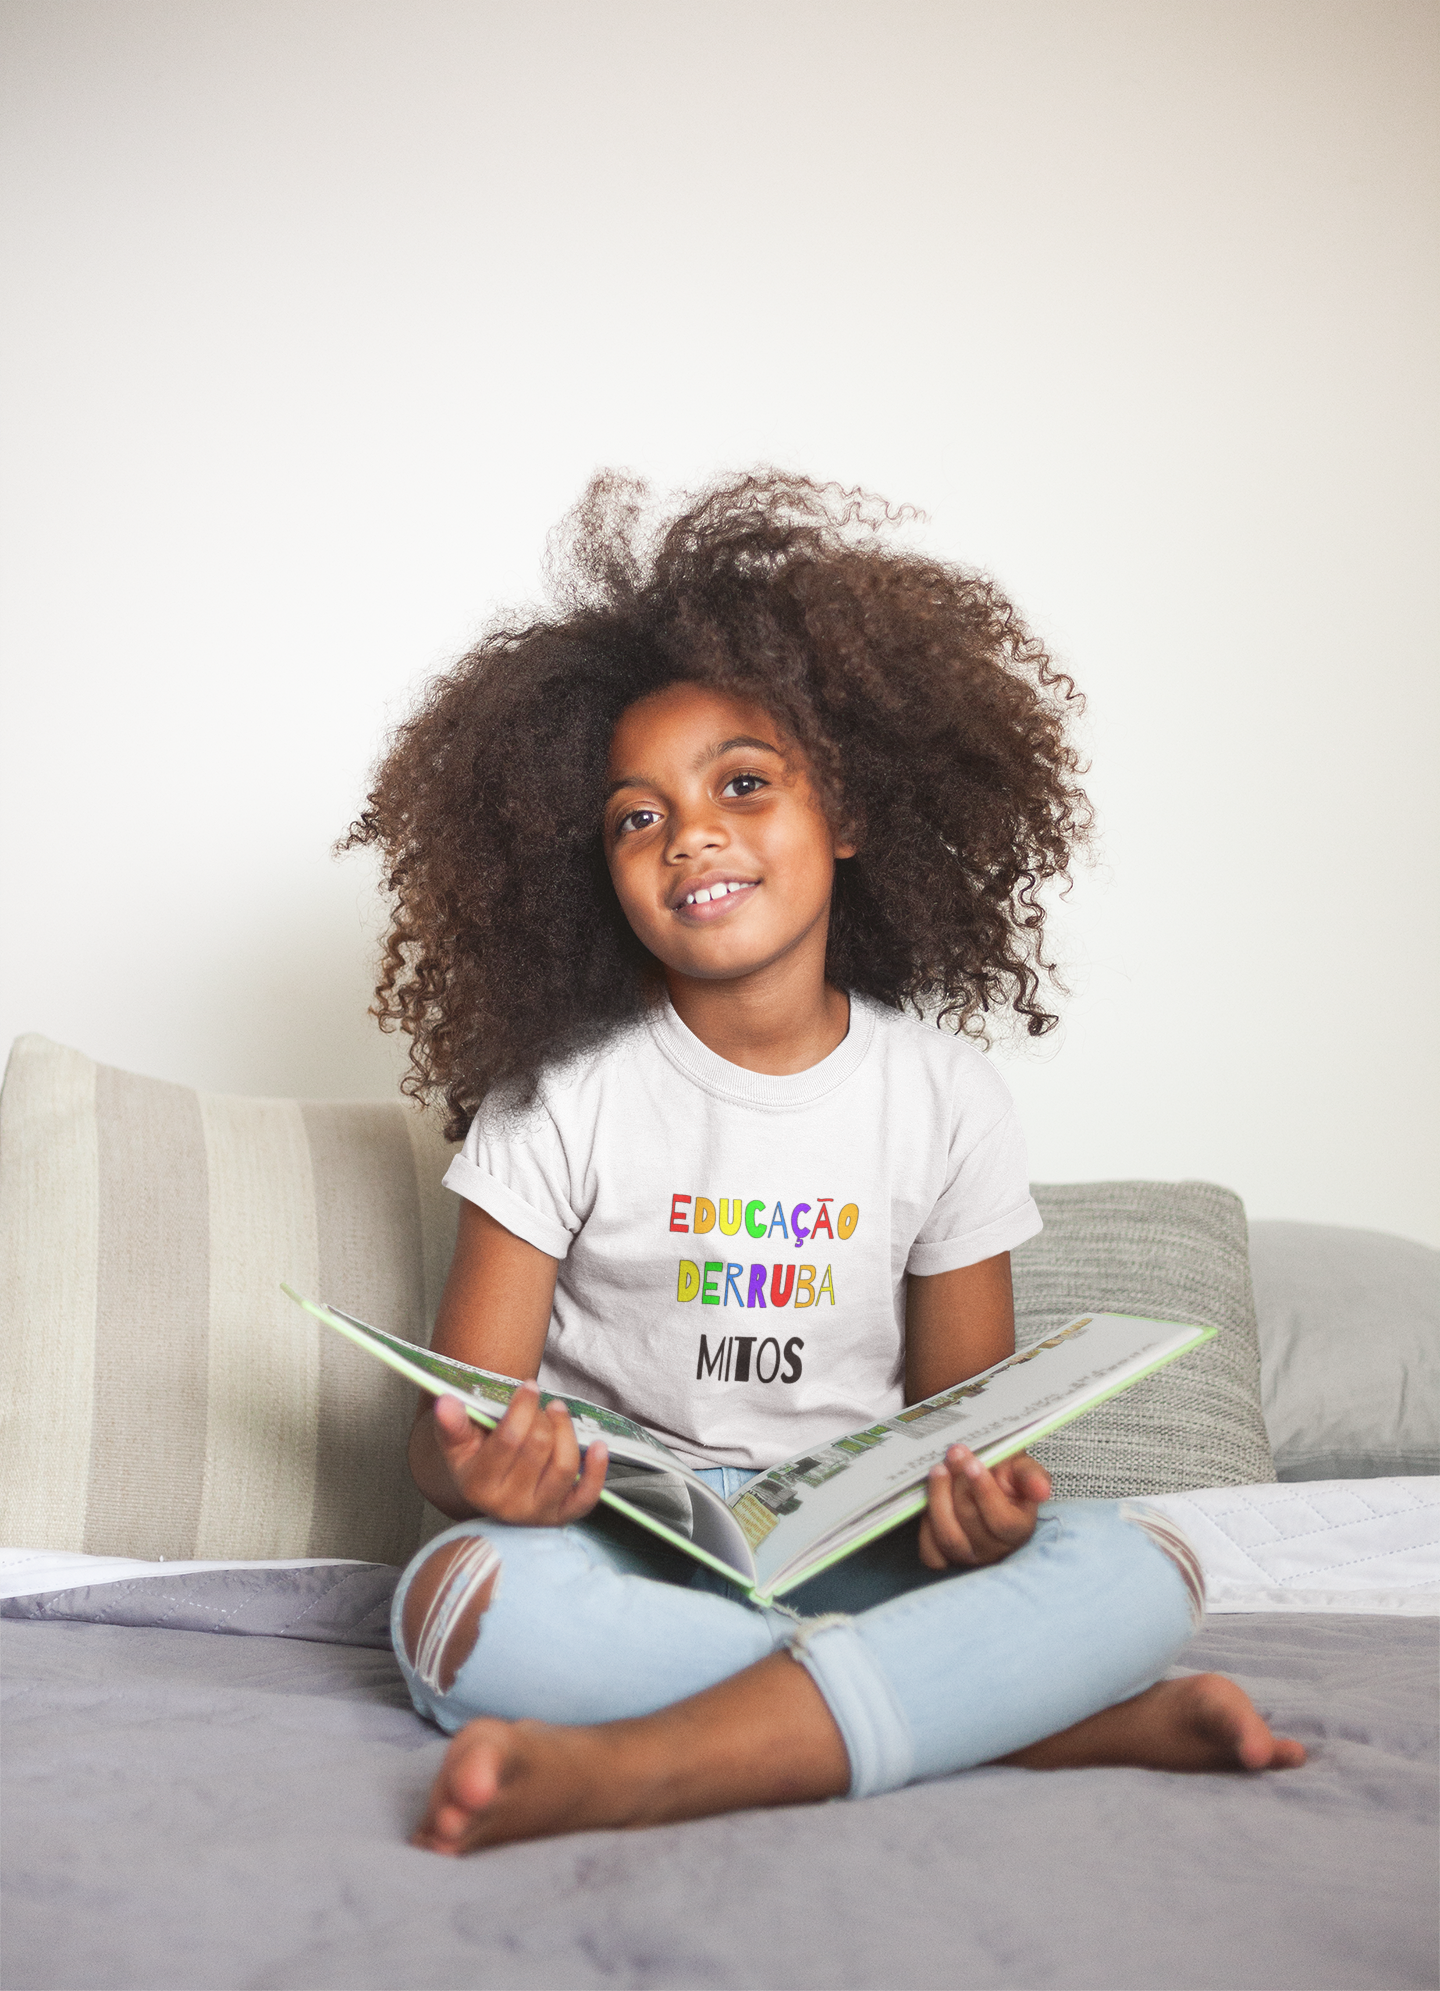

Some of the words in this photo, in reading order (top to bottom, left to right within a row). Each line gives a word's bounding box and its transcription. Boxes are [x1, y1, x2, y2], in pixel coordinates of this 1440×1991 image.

[669, 1193, 859, 1248] EDUCAÇÃO
[677, 1259, 836, 1309] DERRUBA
[696, 1334, 805, 1384] MITOS
